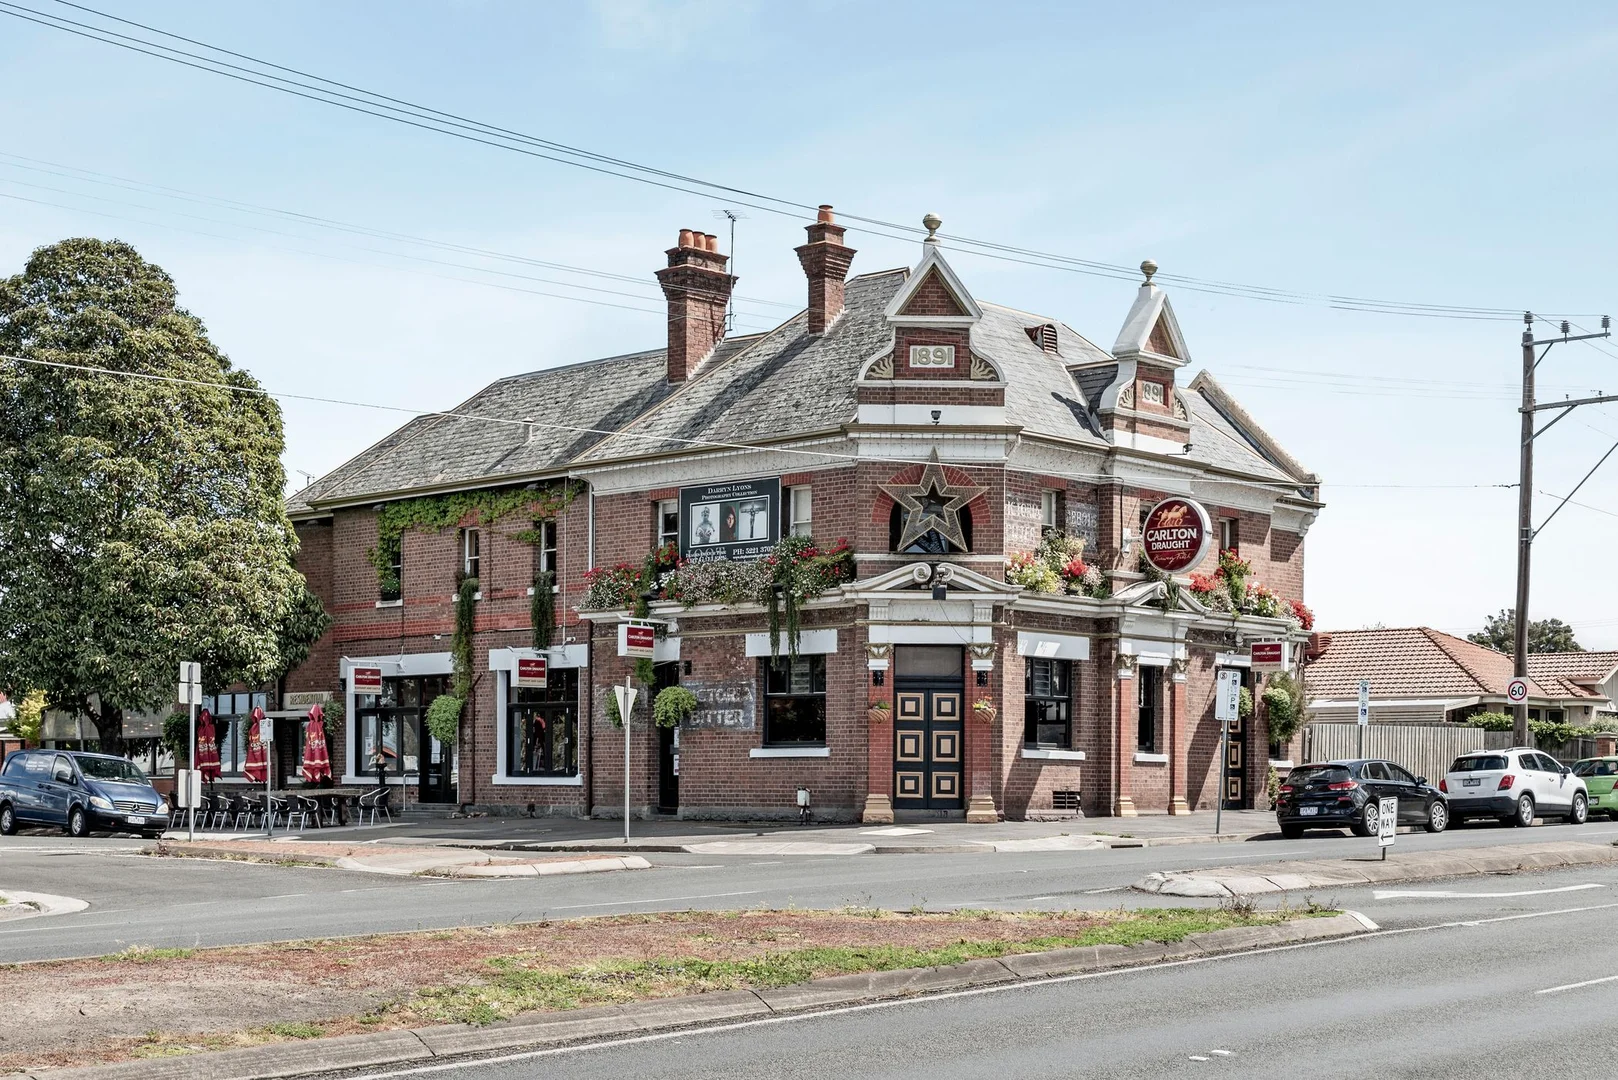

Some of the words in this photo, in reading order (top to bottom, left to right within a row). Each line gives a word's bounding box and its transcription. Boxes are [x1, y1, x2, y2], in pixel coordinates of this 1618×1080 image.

[912, 347, 953, 365] 1891
[707, 486, 731, 494] DARRYN
[732, 490, 758, 498] COLLECTION
[1146, 528, 1197, 541] CARLTON
[1151, 540, 1190, 550] DRAUGHT
[1511, 686, 1524, 696] 60
[1381, 802, 1395, 814] ONE
[1380, 818, 1394, 829] WAY
